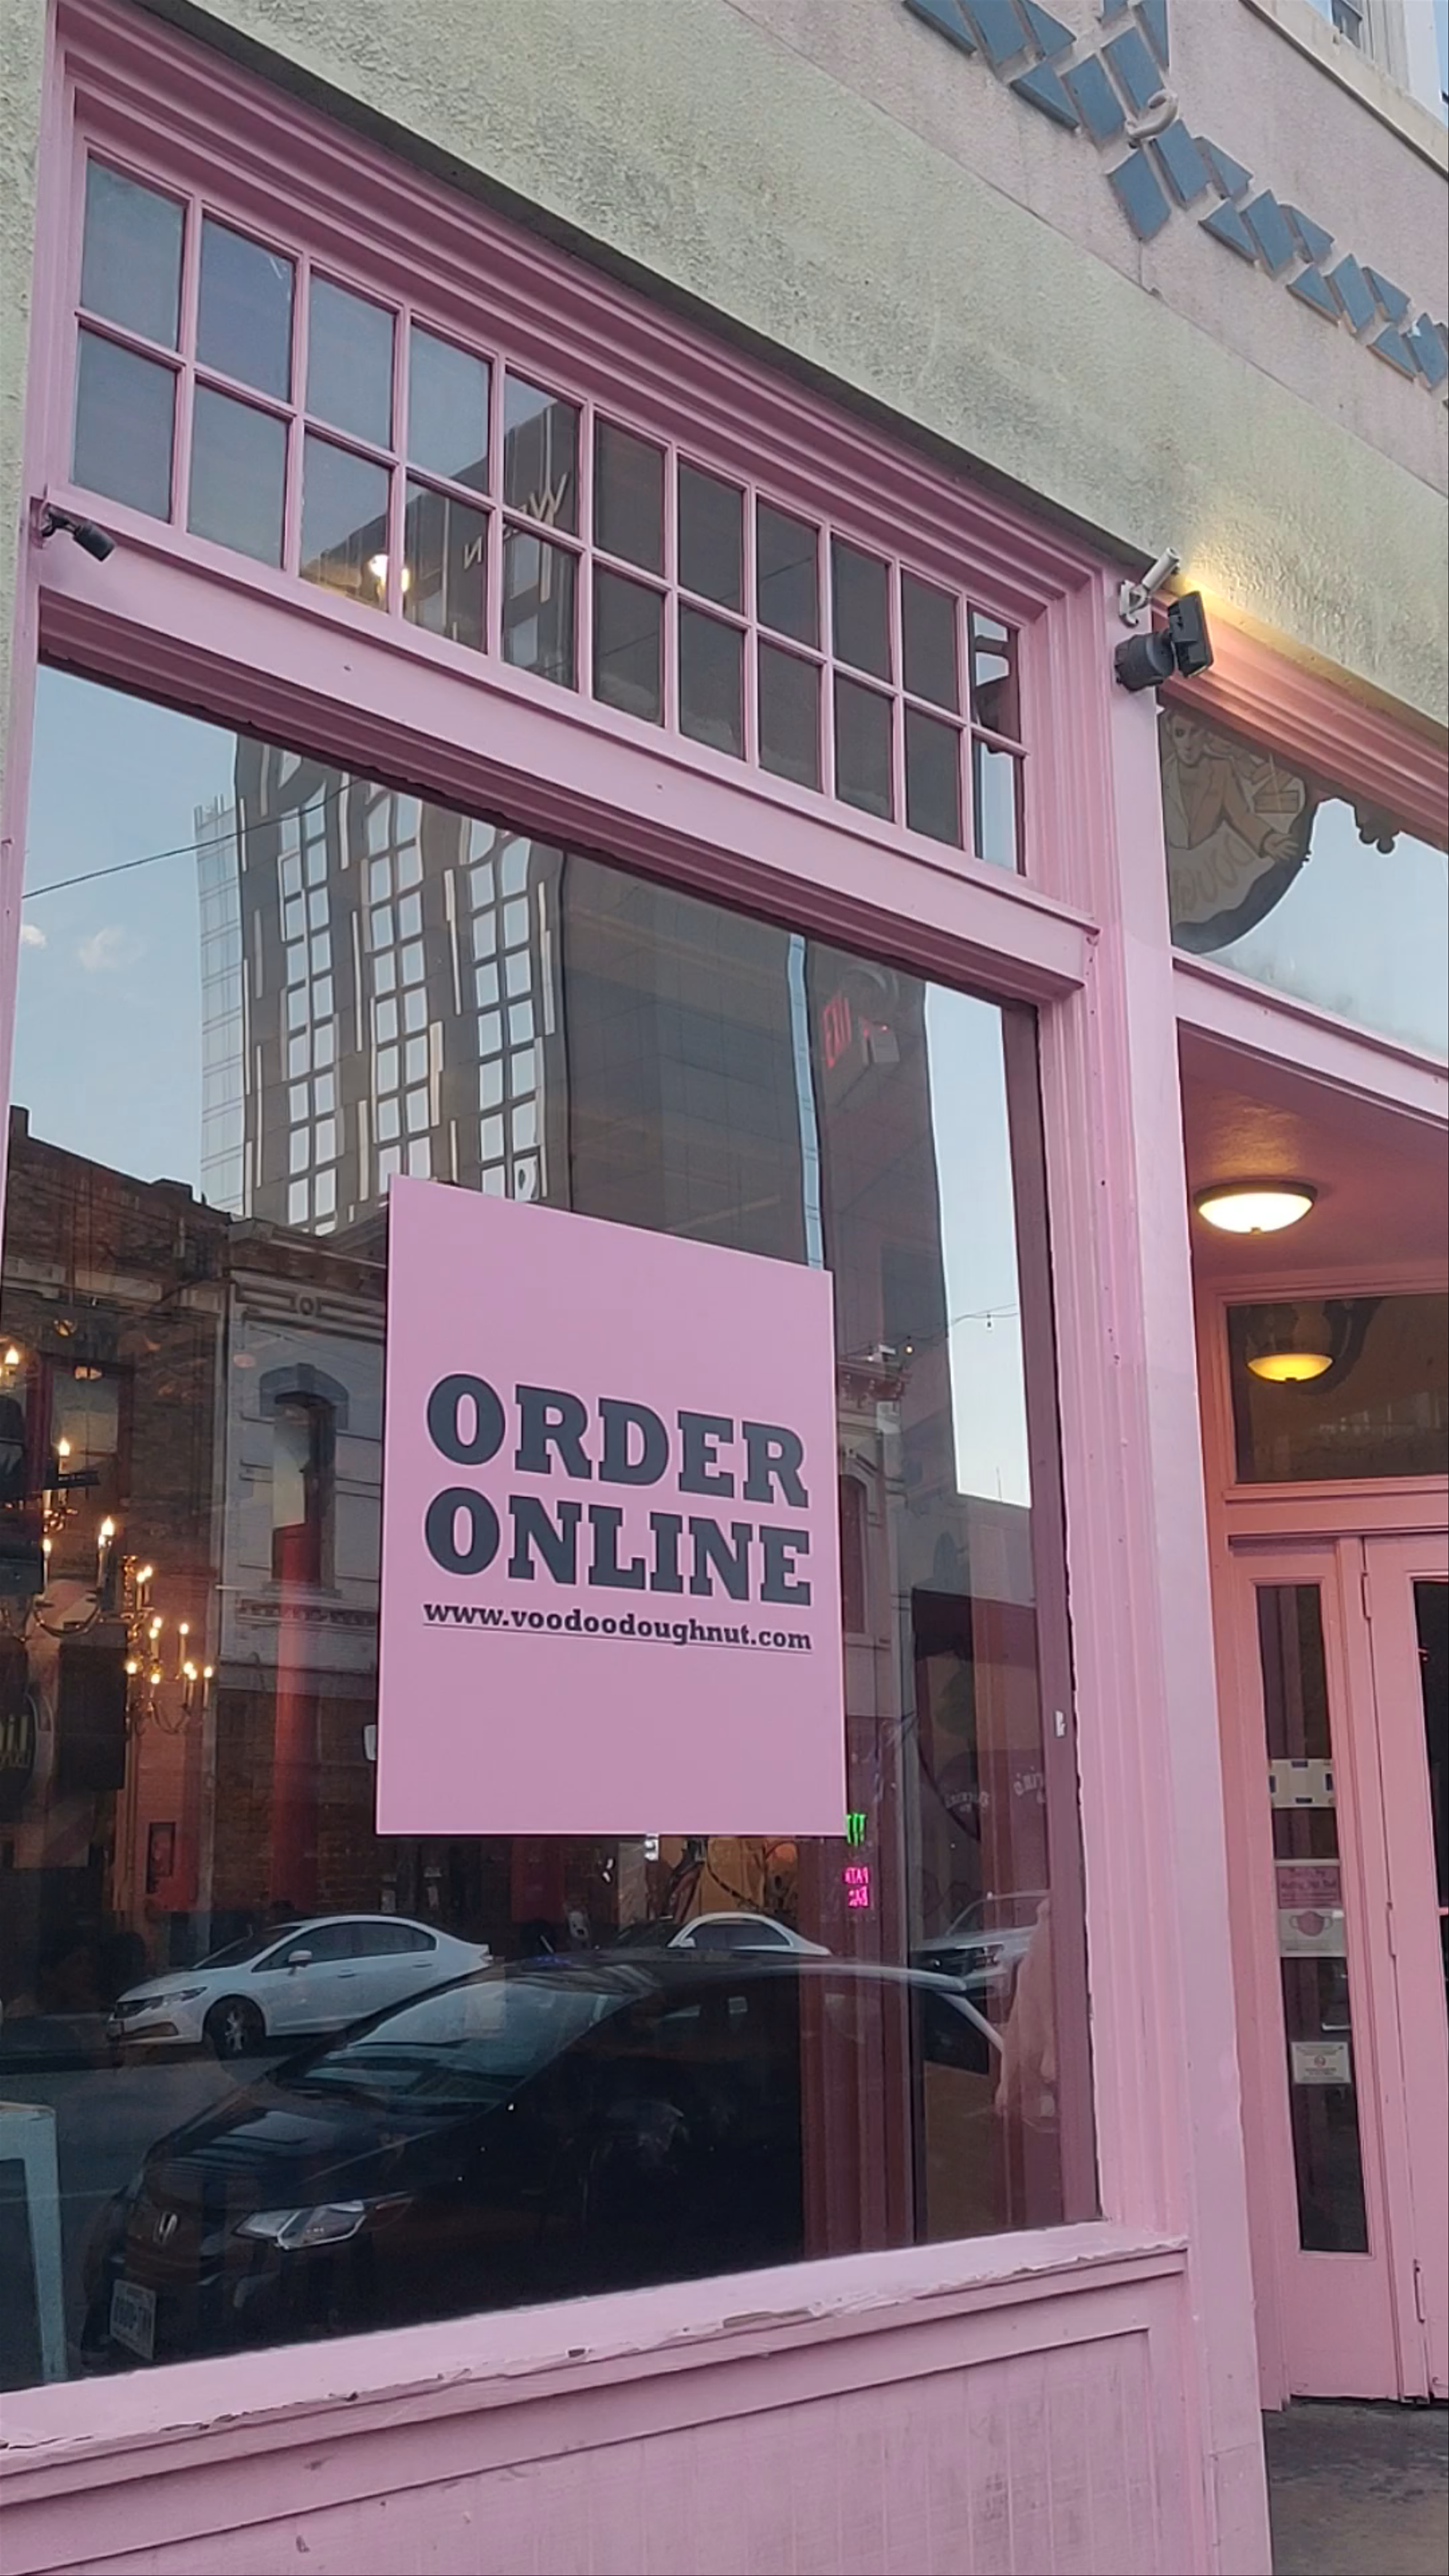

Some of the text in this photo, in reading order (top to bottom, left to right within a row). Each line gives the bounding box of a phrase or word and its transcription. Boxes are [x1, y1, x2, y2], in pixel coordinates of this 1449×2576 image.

[426, 1373, 809, 1508] ORDER
[425, 1487, 811, 1606] ONLINE
[423, 1603, 812, 1650] www.voodoodoughnut.com
